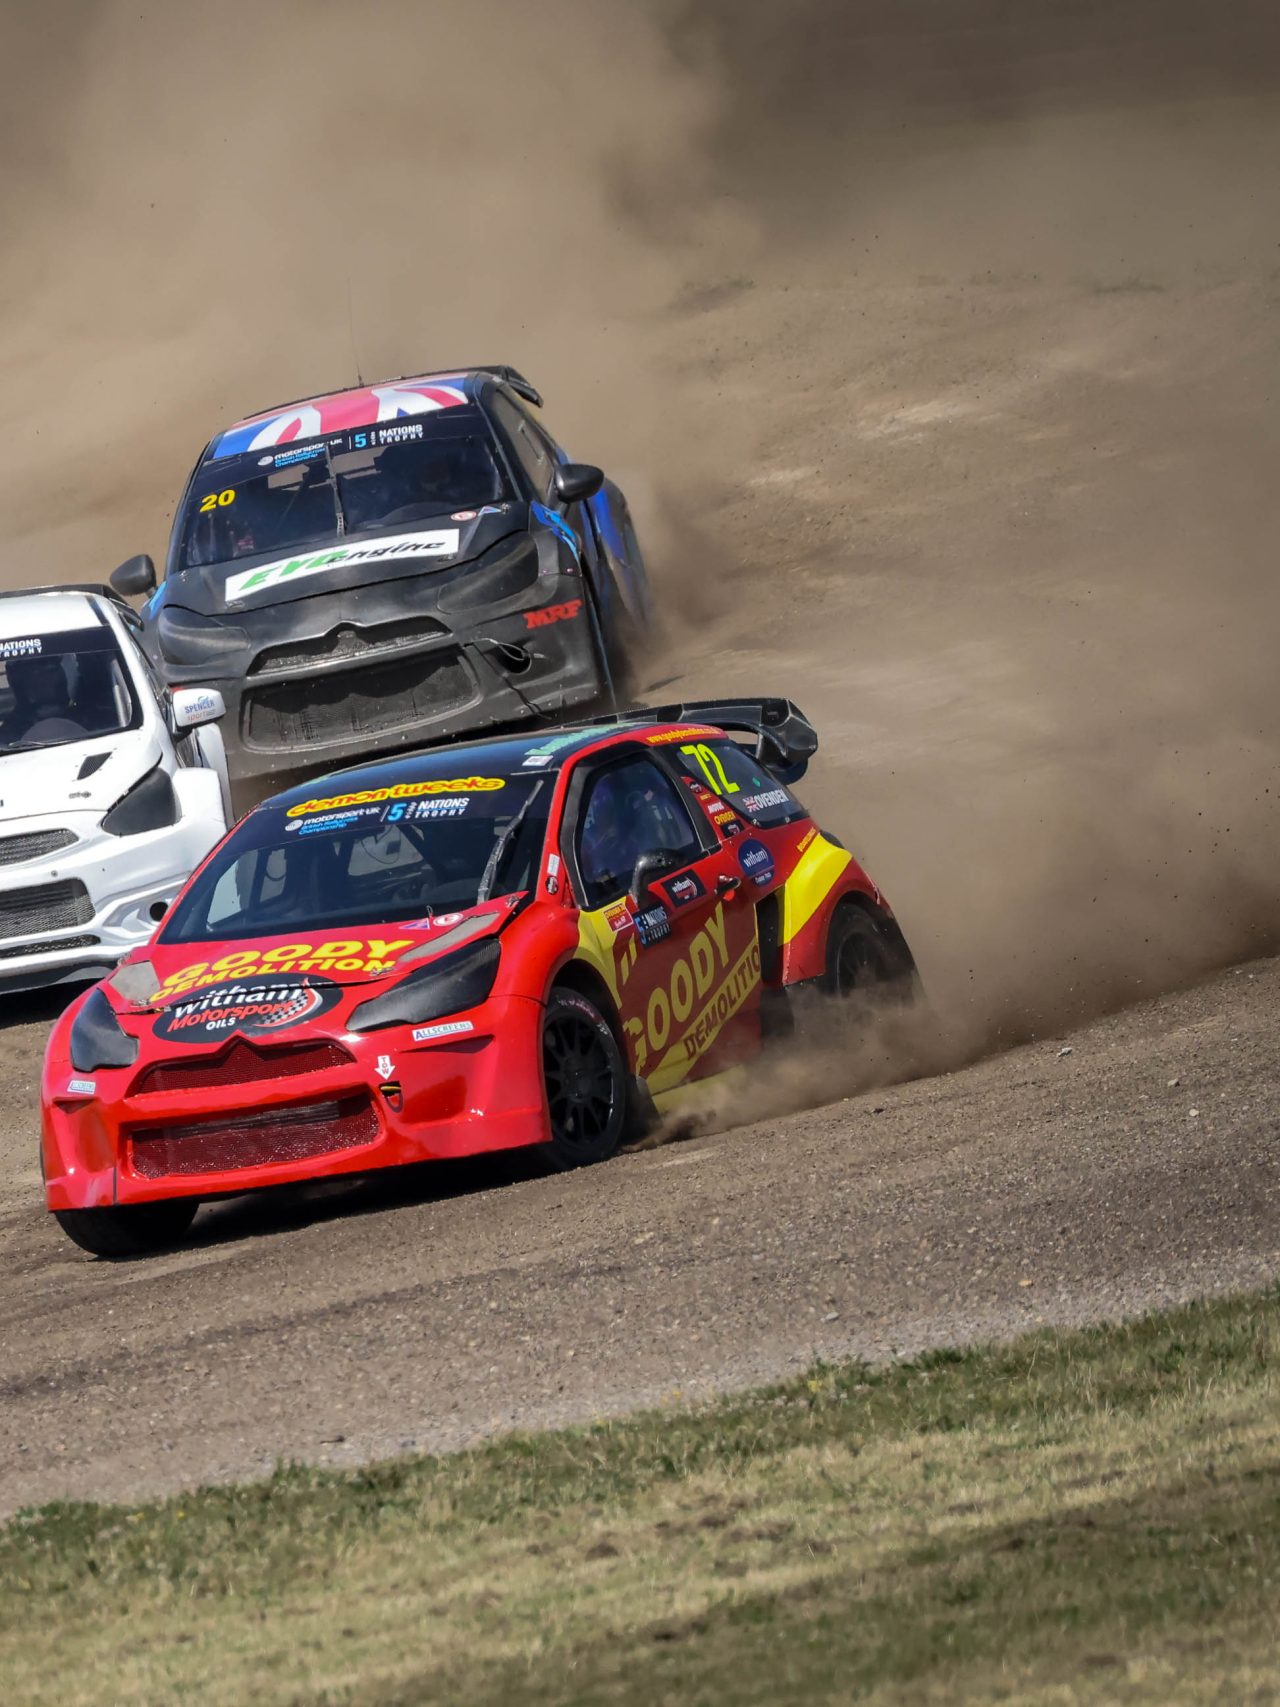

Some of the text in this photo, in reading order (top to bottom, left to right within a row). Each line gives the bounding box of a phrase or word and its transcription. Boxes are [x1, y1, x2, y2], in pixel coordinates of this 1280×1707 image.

[380, 424, 423, 438] NATIONS
[380, 432, 423, 444] TROPHY
[355, 433, 367, 448] 5
[274, 442, 329, 460] motorspor
[200, 489, 236, 513] 20
[523, 599, 583, 629] MRF
[184, 699, 215, 714] SPENCER
[680, 743, 740, 795] 72
[417, 797, 470, 811] NATIONS
[754, 789, 789, 809] OVENDEN
[304, 806, 381, 826] motorsport UK
[388, 803, 407, 821] 5
[414, 808, 465, 819] TROPHY
[162, 940, 415, 988] GOODY
[149, 958, 397, 1003] DEMOLITION
[175, 983, 302, 1018] witham
[206, 1017, 236, 1031] OILS
[416, 1023, 473, 1040] ALLSCREENS
[381, 1056, 390, 1075] TOW
